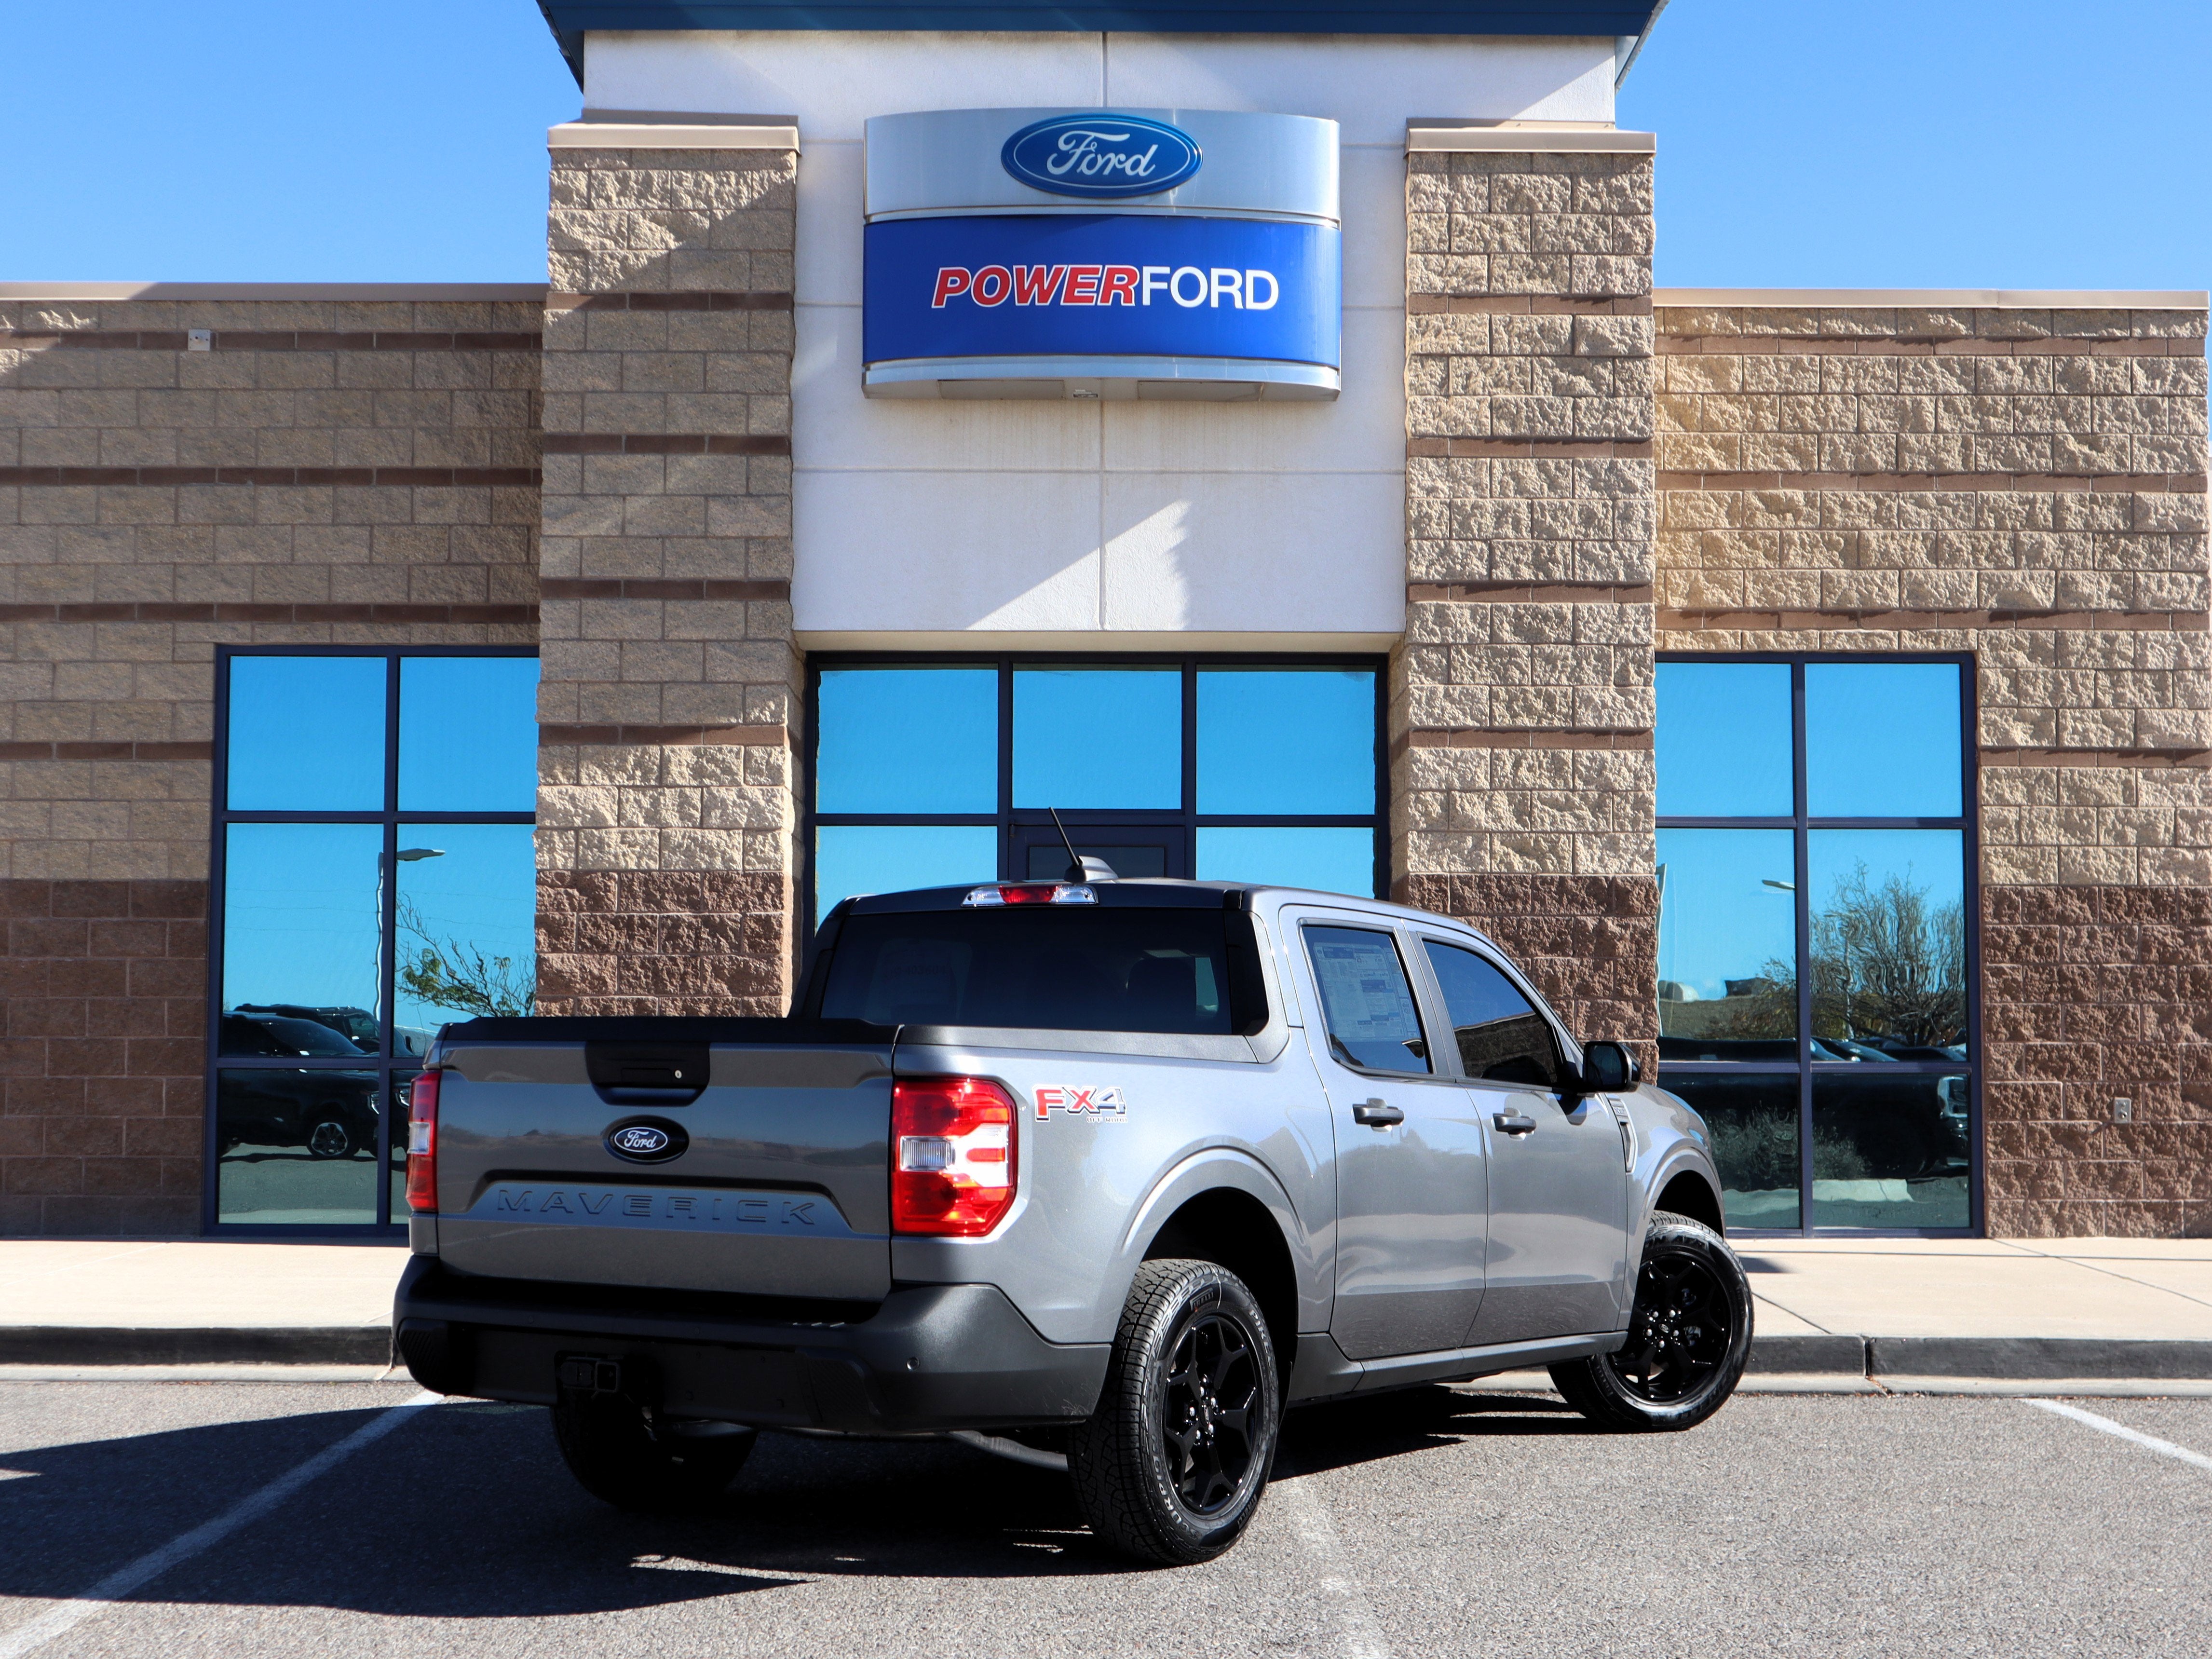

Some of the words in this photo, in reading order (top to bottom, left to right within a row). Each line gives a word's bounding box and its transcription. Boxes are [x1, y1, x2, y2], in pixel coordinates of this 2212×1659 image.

[1046, 130, 1156, 177] Ford
[931, 264, 1279, 310] POWERFORD
[1032, 1085, 1127, 1122] FX4
[624, 1130, 658, 1148] Ford
[498, 1189, 815, 1225] MAVERICK
